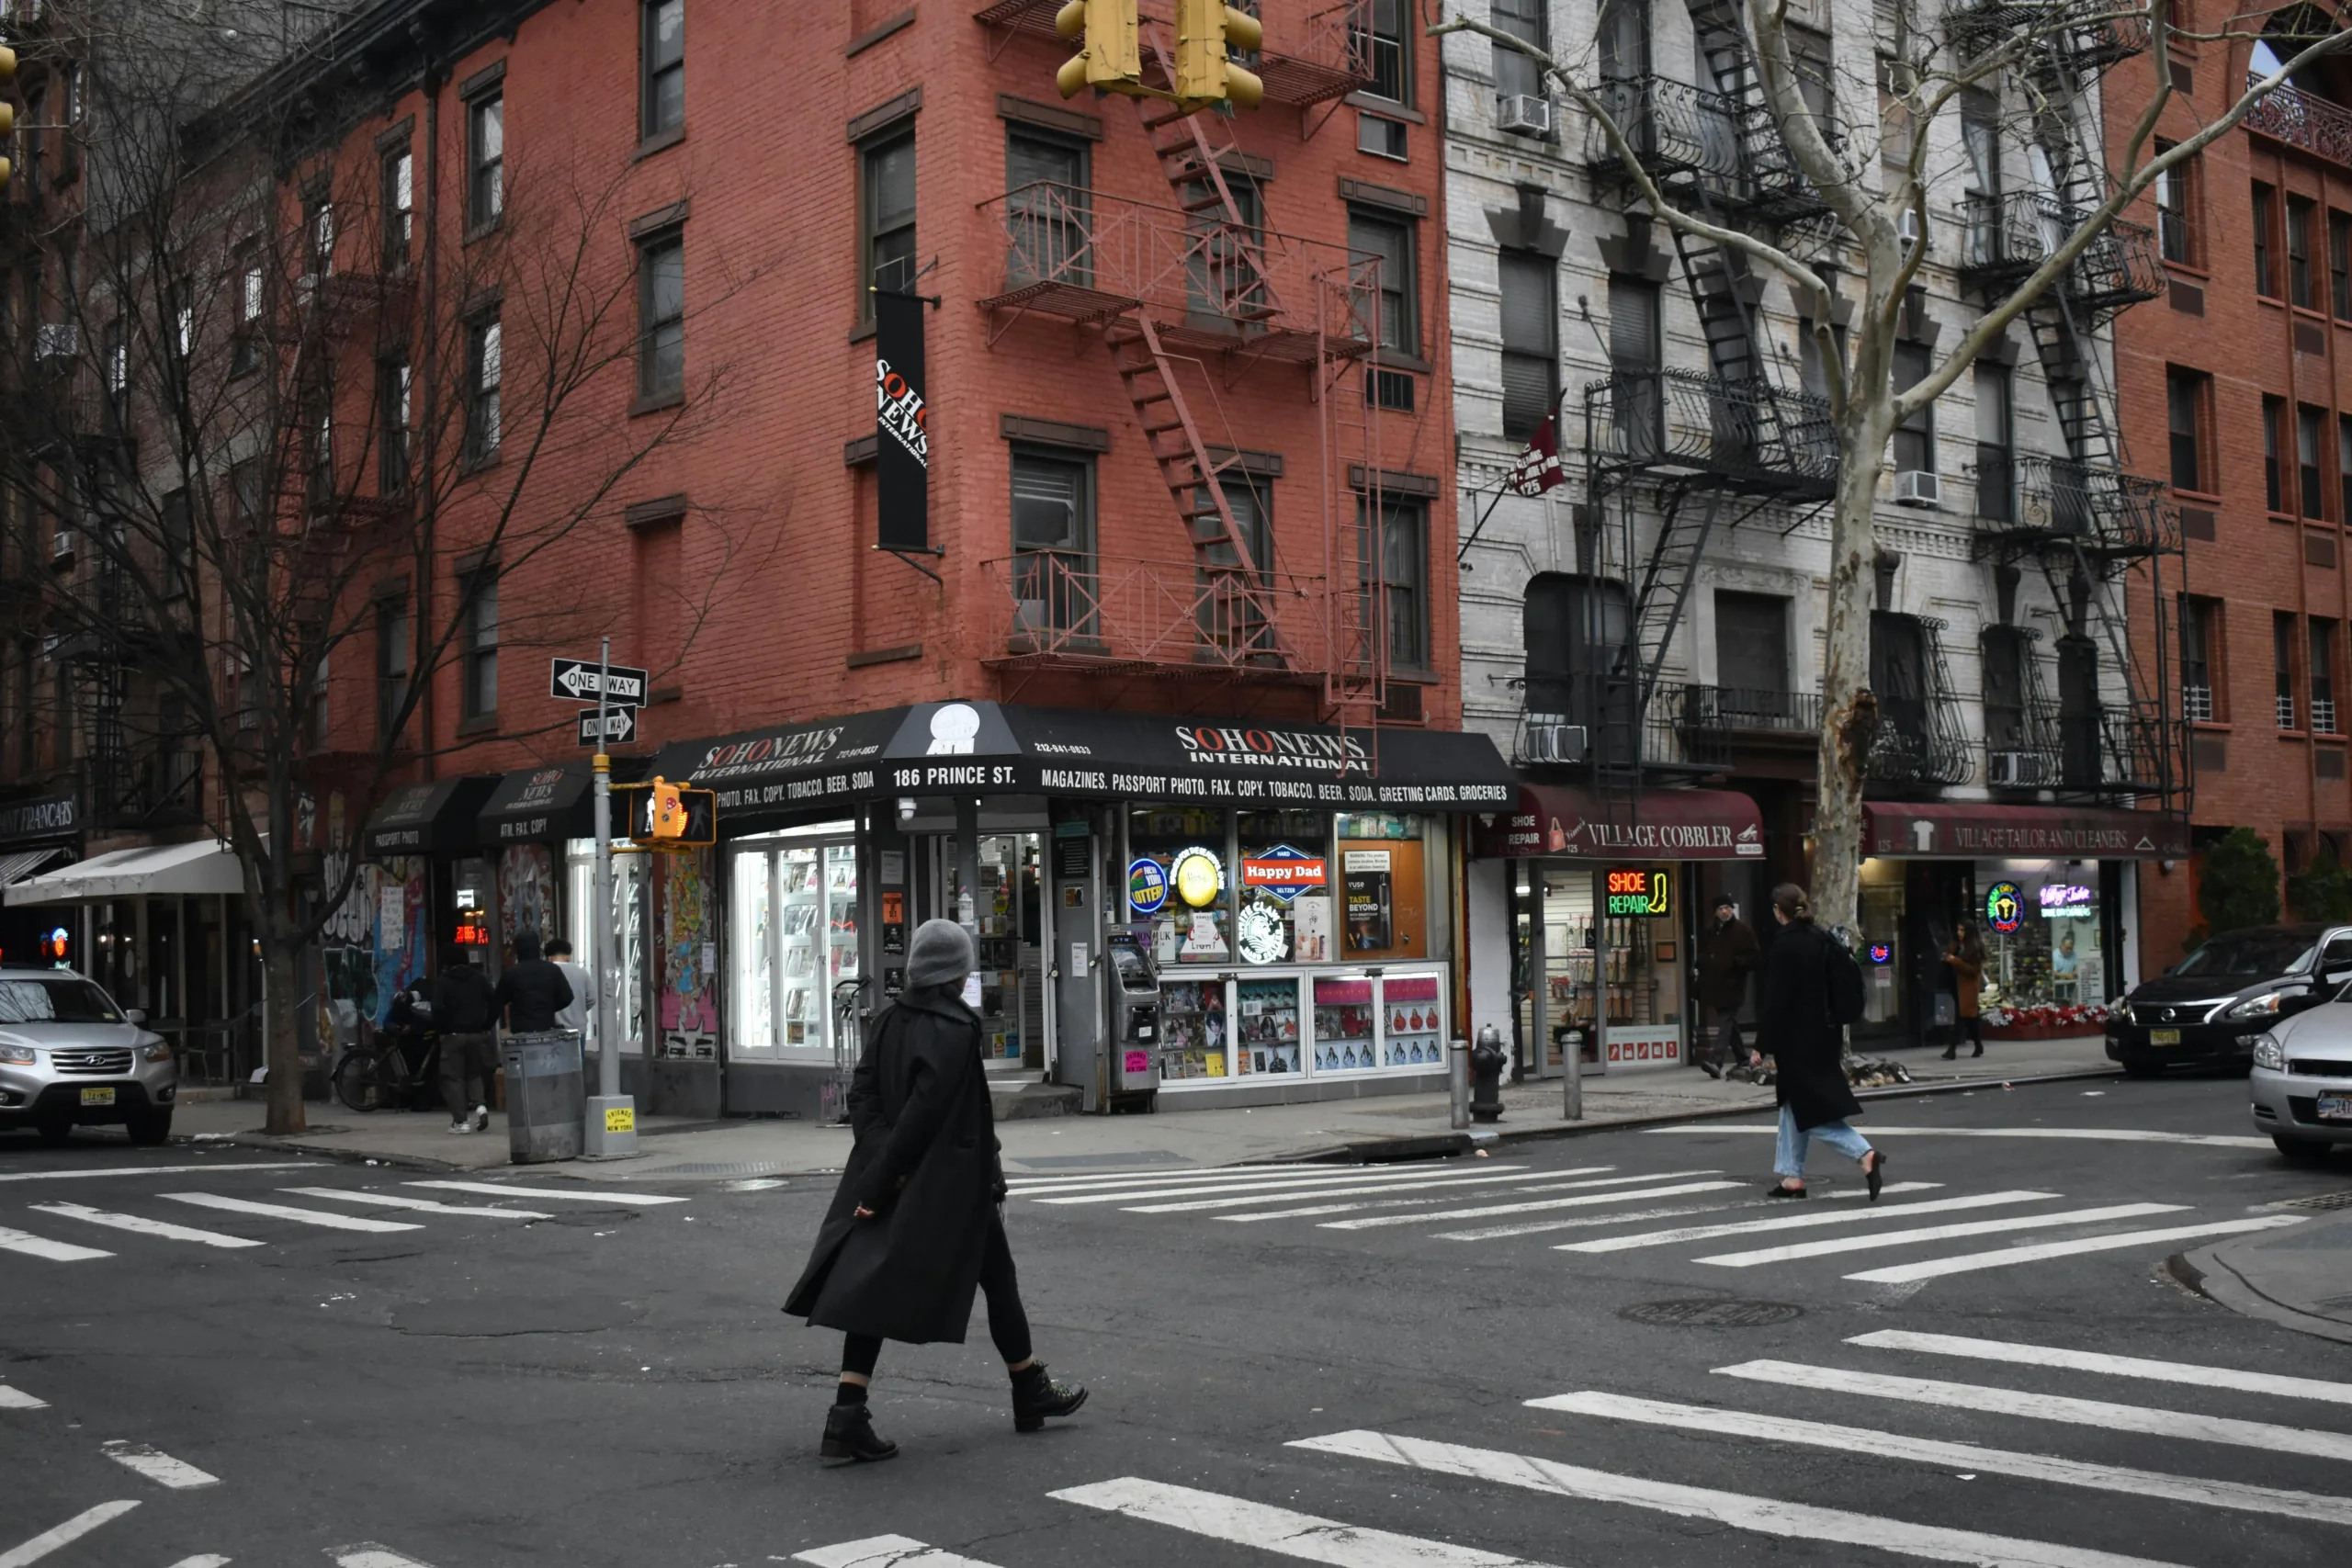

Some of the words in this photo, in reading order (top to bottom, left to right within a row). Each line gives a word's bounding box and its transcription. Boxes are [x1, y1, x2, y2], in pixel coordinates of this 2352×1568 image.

[876, 384, 928, 456] NEWS
[877, 416, 928, 468] INTERNATIONAL
[1520, 479, 1542, 496] 125
[569, 672, 595, 690] ONE
[608, 677, 635, 694] WAY
[586, 720, 600, 736] ON
[610, 716, 628, 733] WAY
[1035, 742, 1091, 755] 212-941-0833
[688, 751, 827, 781] INTERNATIONAL
[1190, 750, 1373, 772] INTERNATIONAL
[528, 768, 565, 786] SOHO
[893, 769, 921, 787] 186
[927, 766, 986, 785] PRINCE
[993, 766, 1016, 784] ST.
[518, 784, 556, 801] NEWS
[717, 790, 742, 808] PHOTO.
[744, 788, 761, 805] FAX.
[763, 785, 785, 804] COPY.
[787, 778, 824, 800] TOBACCO.
[827, 774, 850, 795] BEER.
[853, 770, 875, 790] SODA
[1042, 769, 1108, 790] MAGAZINES.
[1113, 775, 1166, 794] PASSPORT
[1171, 777, 1208, 796] PHOTO.
[1211, 779, 1235, 796] FAX.
[1238, 780, 1266, 797] COPY.
[1269, 781, 1316, 800] TOBACCO.
[1318, 784, 1346, 801] BEER.
[1349, 784, 1376, 803] SODA.
[1379, 785, 1423, 803] GREETING
[1426, 785, 1458, 802] CARDS.
[1460, 785, 1507, 801] GROCERIES
[515, 820, 528, 837] FAX.
[531, 818, 548, 834] COPY
[1511, 815, 1535, 827] SHOE
[375, 830, 401, 848] PASSPORT
[401, 830, 419, 844] PHOTO
[1509, 832, 1540, 845] REPAIR
[1588, 824, 1659, 847] VILLAGE
[1660, 825, 1733, 847] COBBLER
[1955, 828, 2004, 849] VILLAGE
[2006, 829, 2049, 849] TAILOR
[2049, 829, 2072, 849] AND
[2075, 829, 2128, 849] CLEANERS
[1566, 844, 1578, 853] 125
[1143, 865, 1158, 875] NEW
[1247, 865, 1293, 879] Happy
[1295, 865, 1322, 877] Dad
[1146, 874, 1162, 886] YORK
[1609, 872, 1645, 892] SHOE
[1131, 885, 1164, 904] LOTTERY
[1999, 885, 2015, 894] DRY
[1349, 896, 1371, 904] TASTE
[1349, 903, 1379, 912] BEYOND
[1609, 895, 1649, 914] REPAIR
[1988, 888, 2000, 919] WASH
[1253, 901, 1281, 922] CLAW
[1996, 919, 2018, 931] OPEN
[1135, 930, 1171, 941] MONUK
[607, 1109, 632, 1120] FRIENDS
